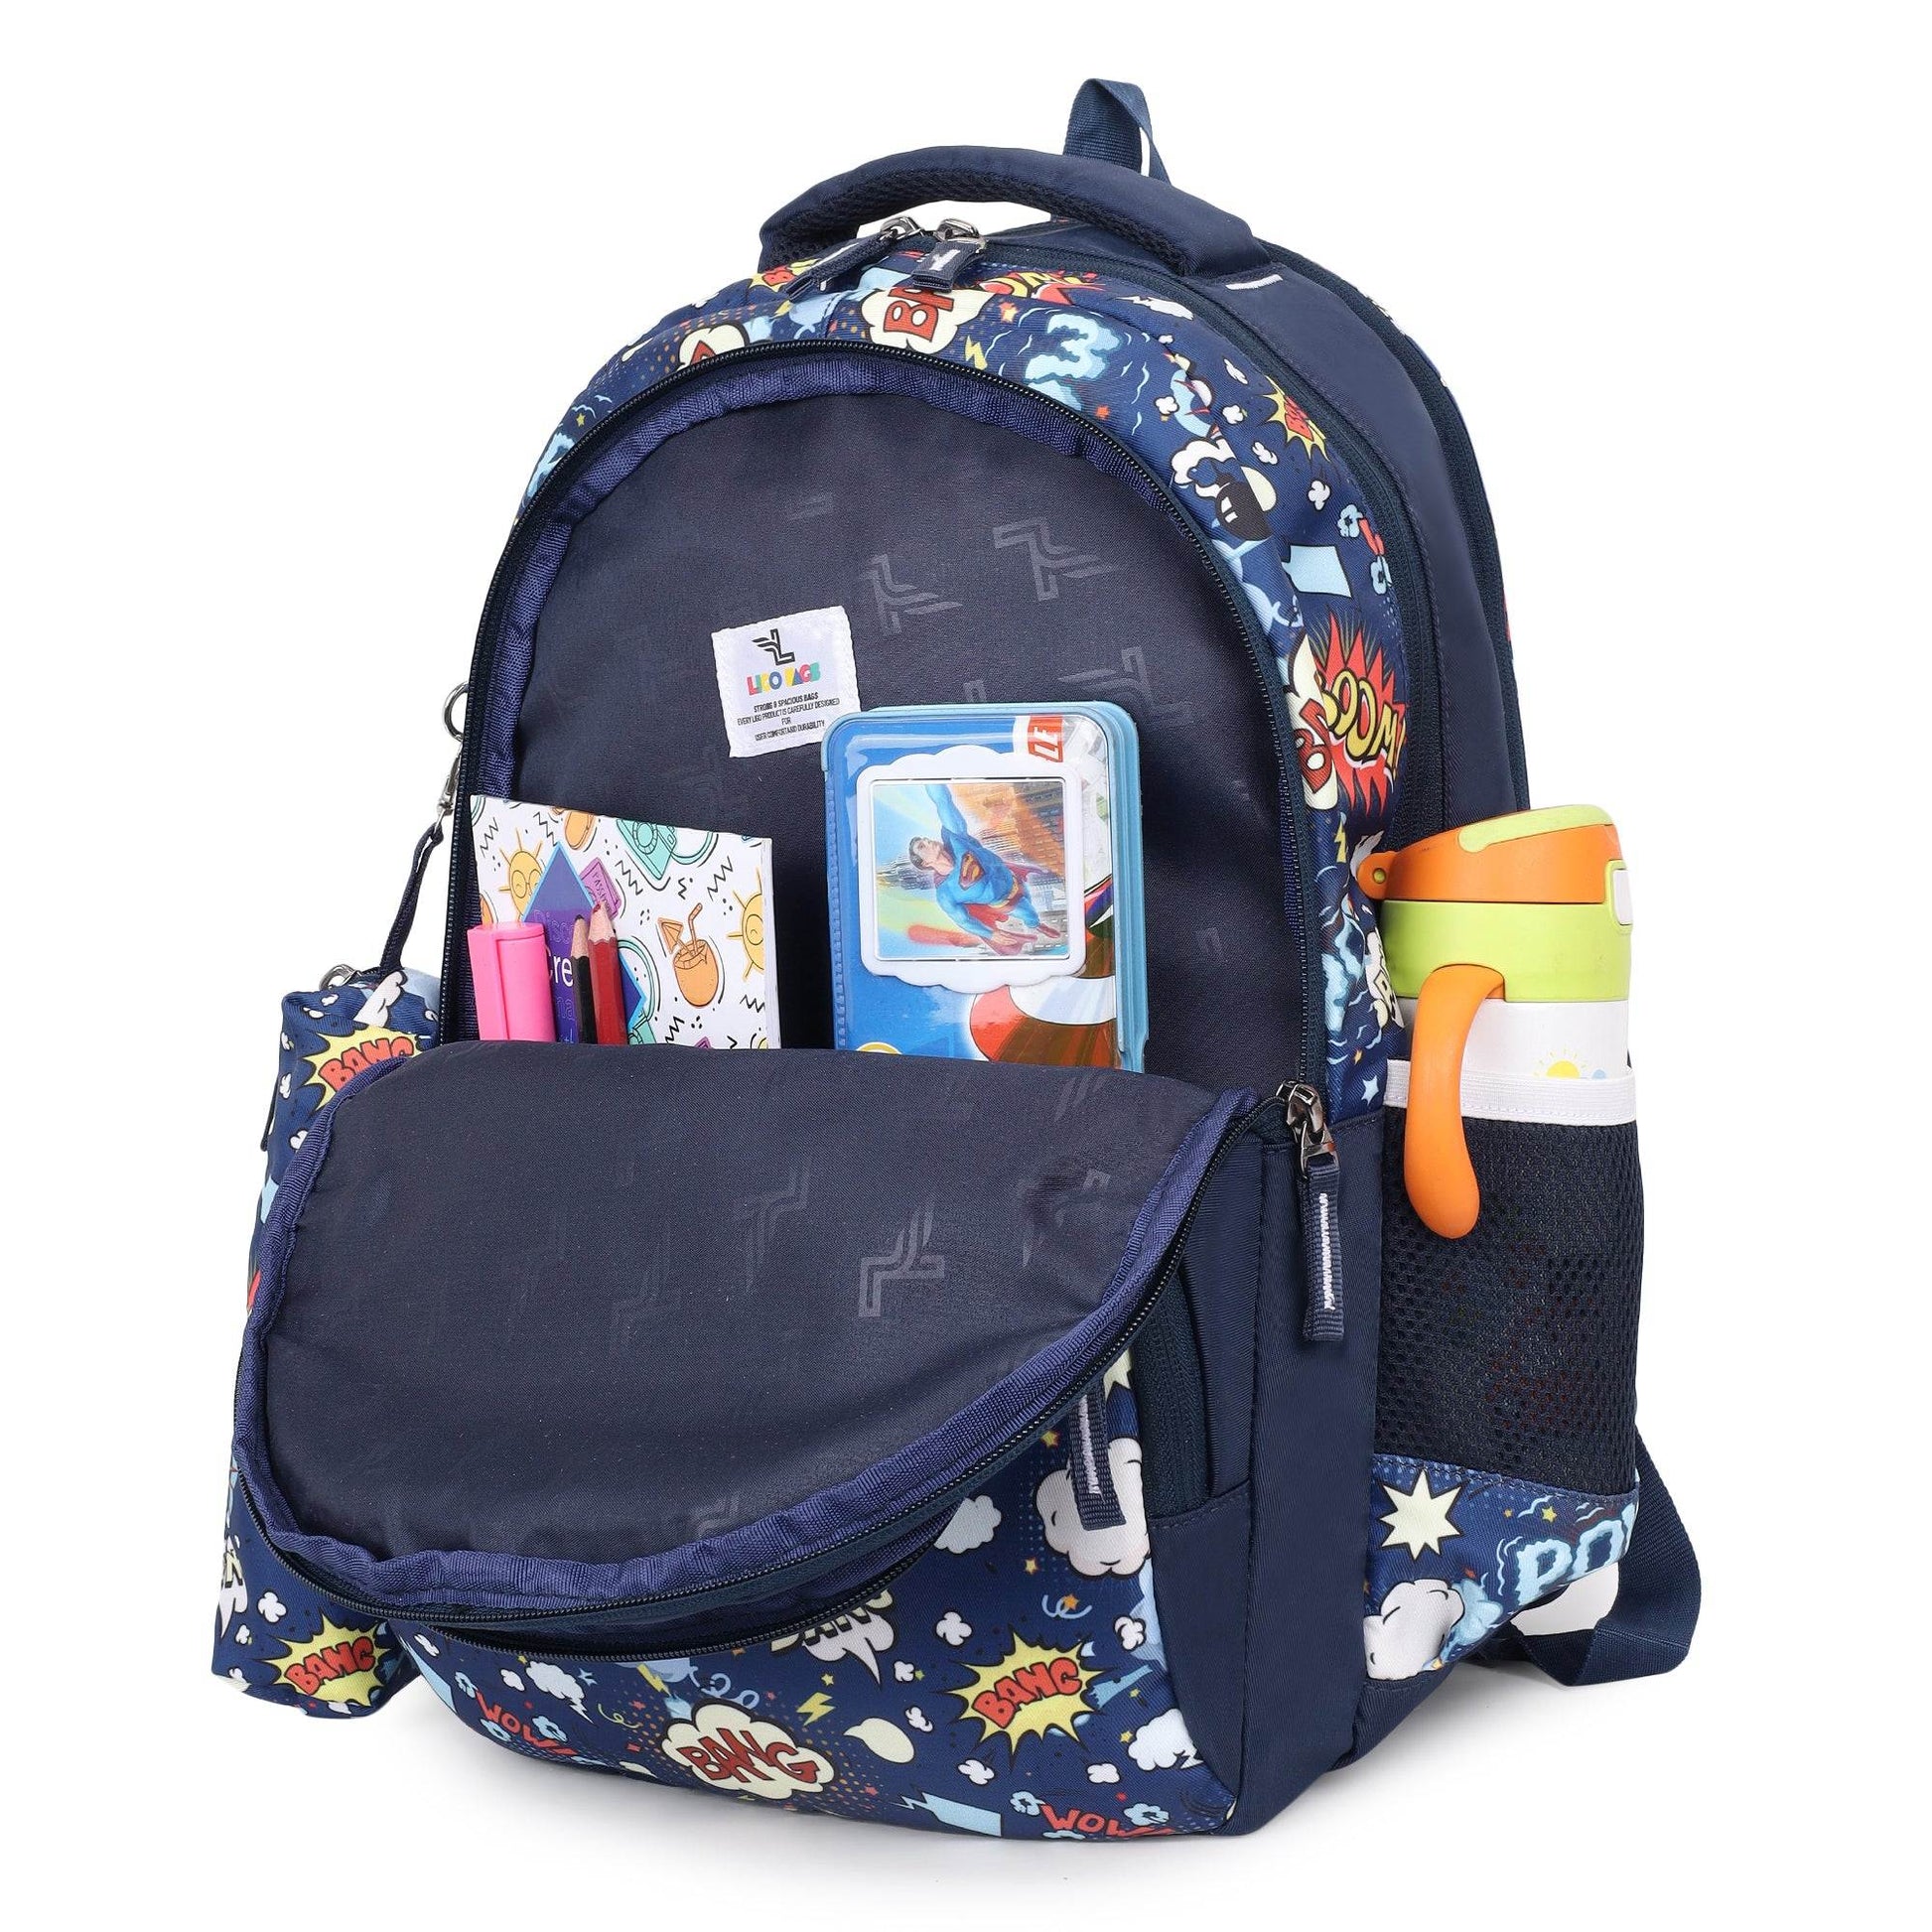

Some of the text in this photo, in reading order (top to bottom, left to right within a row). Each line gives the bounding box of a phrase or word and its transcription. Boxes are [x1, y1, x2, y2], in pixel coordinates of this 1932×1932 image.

[737, 715, 753, 726] EVERY
[762, 709, 782, 721] PRODUCT
[787, 703, 815, 715] CAREFULLY
[814, 697, 841, 709] DESIGNED
[777, 695, 803, 708] SPACIOUS
[803, 691, 819, 702] BAGS
[766, 727, 787, 739] COMFORT
[797, 719, 825, 732] DURABILITY
[284, 1636, 375, 1696] BANG
[971, 1656, 1083, 1728] BANG
[676, 1727, 822, 1784] BANG
